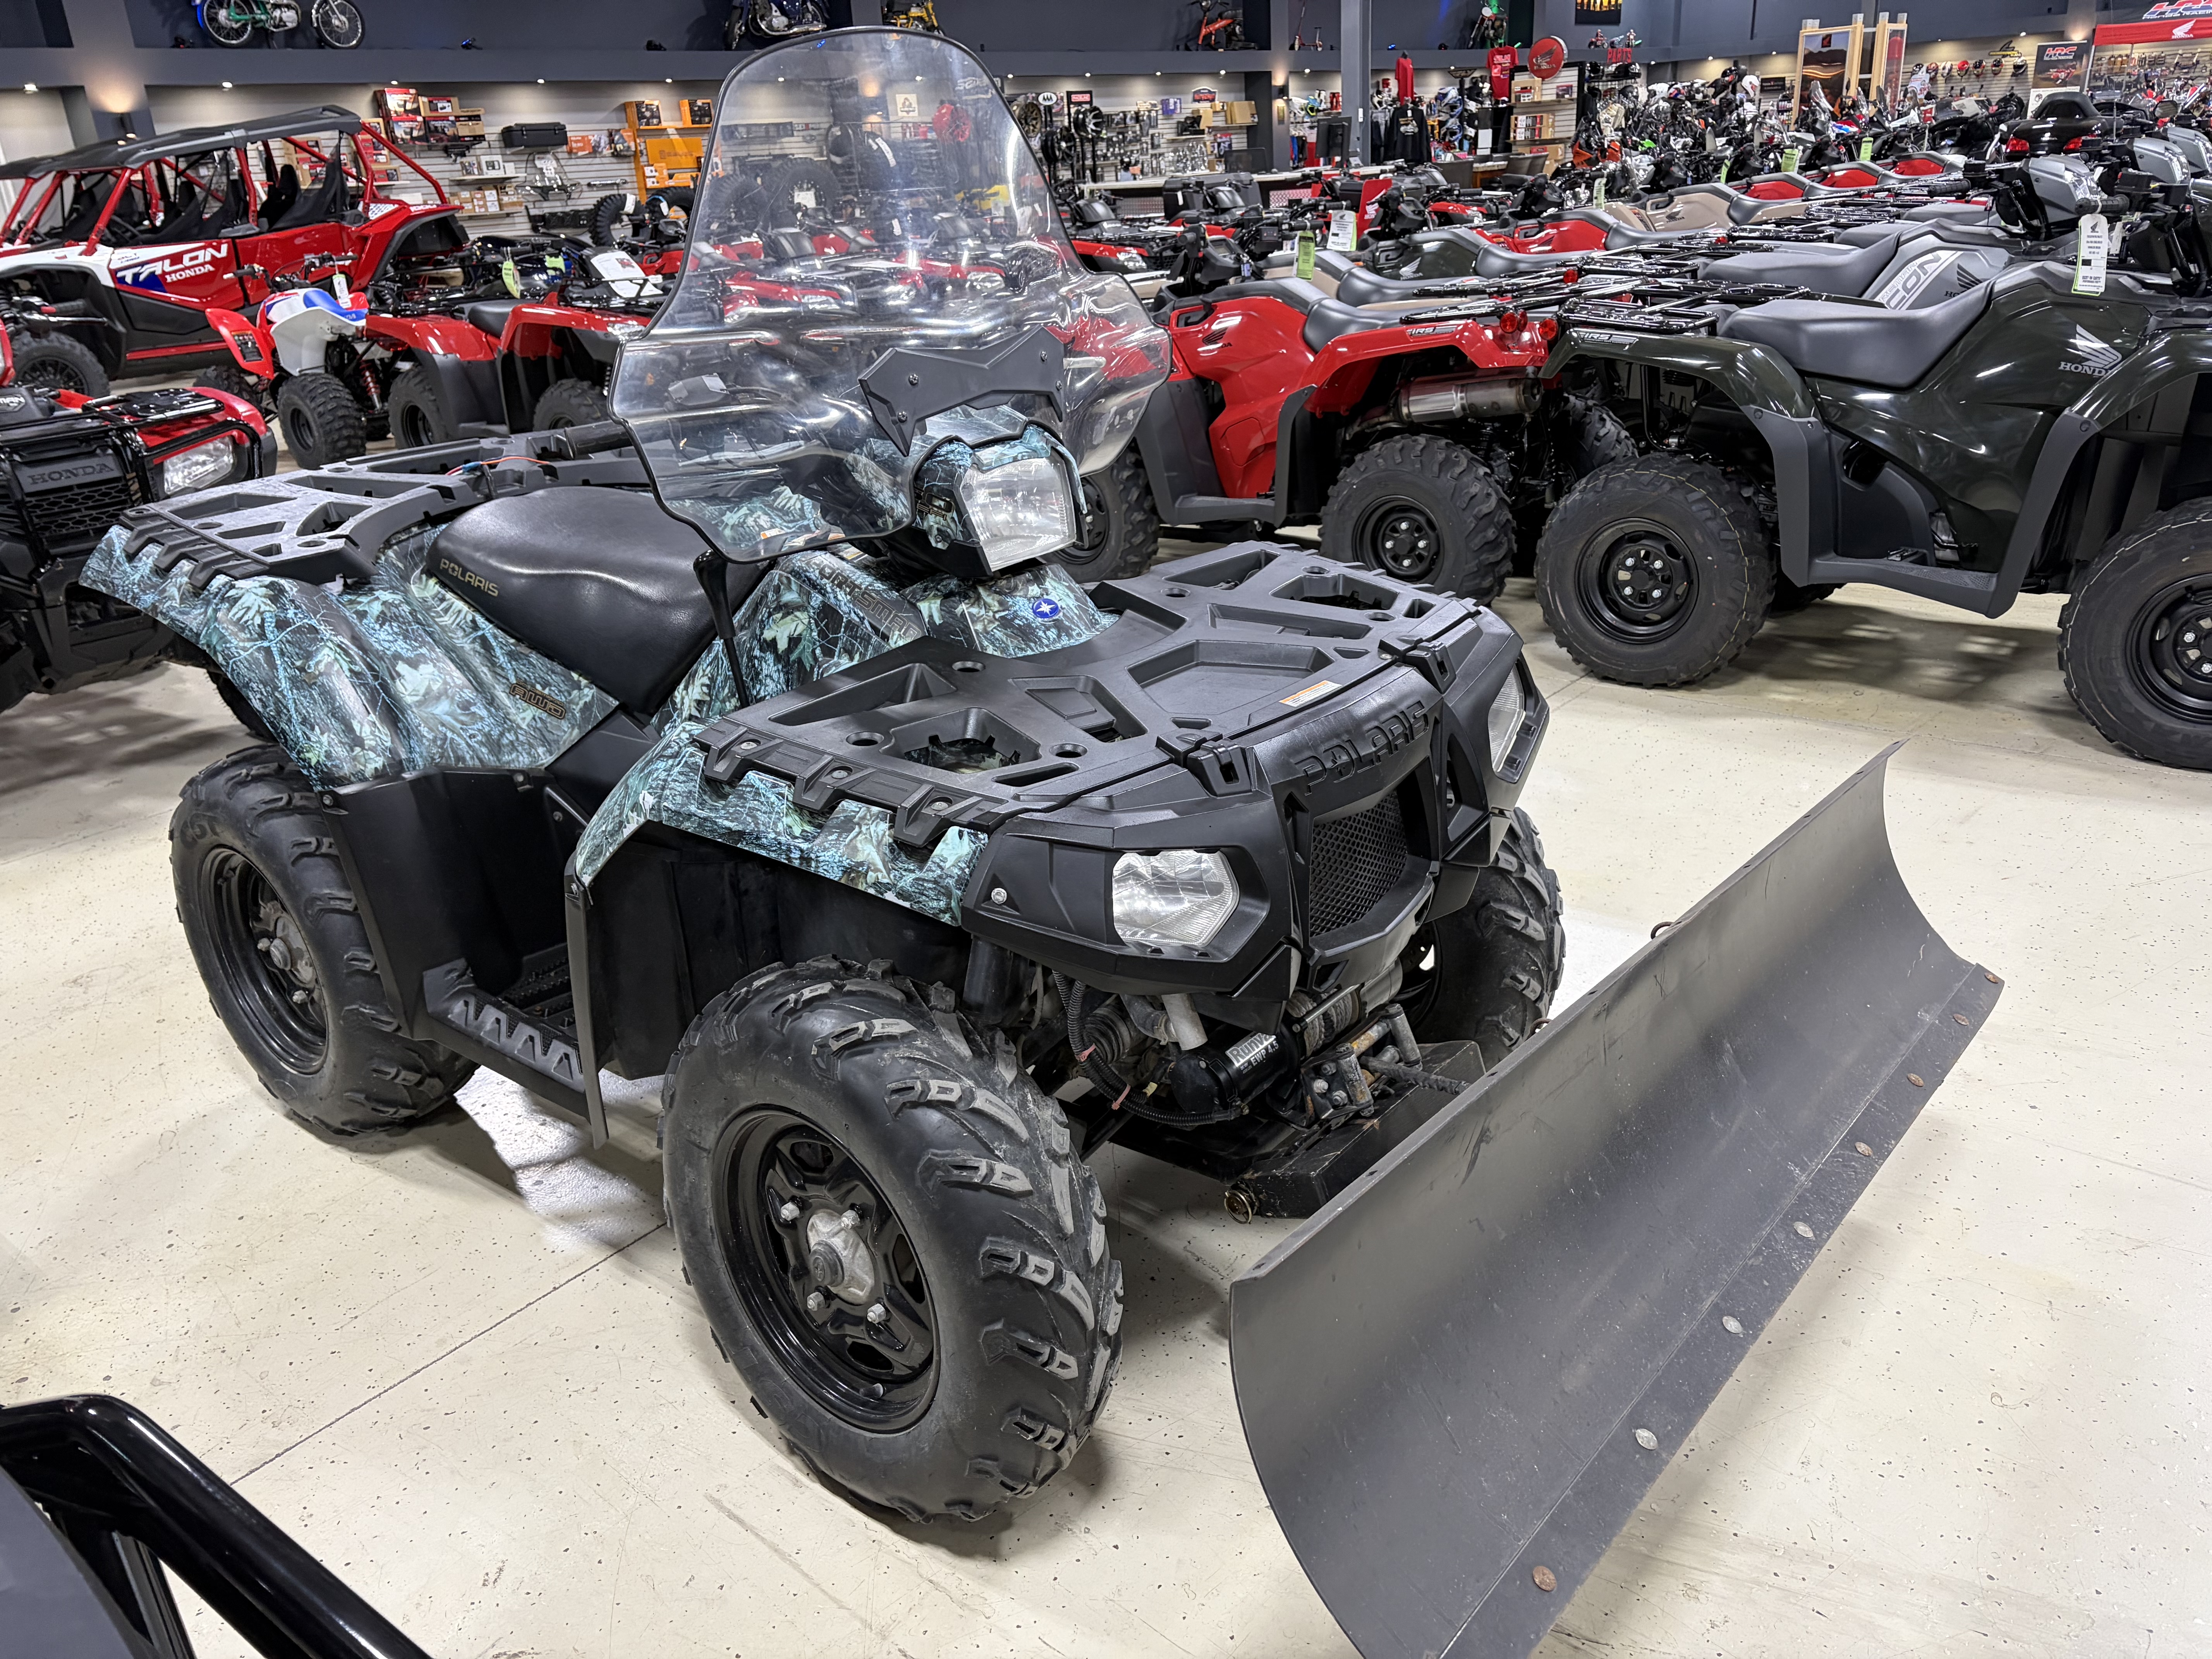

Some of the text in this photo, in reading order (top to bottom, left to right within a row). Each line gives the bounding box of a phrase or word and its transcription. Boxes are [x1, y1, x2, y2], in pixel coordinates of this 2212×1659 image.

[1607, 48, 1632, 64] PARTS
[2044, 46, 2077, 58] HRC
[116, 243, 228, 284] TALON
[165, 264, 215, 283] HONDA
[1400, 273, 1423, 281] HONDA
[1879, 261, 1917, 303] REMAN
[2058, 361, 2111, 377] HOND
[27, 463, 114, 484] HONDA
[440, 558, 499, 597] POLARIS
[809, 560, 922, 641] ORTSMAN
[509, 683, 566, 720] AWD
[1294, 700, 1429, 796] POLARIS
[1250, 1041, 1279, 1066] EWP 4.5
